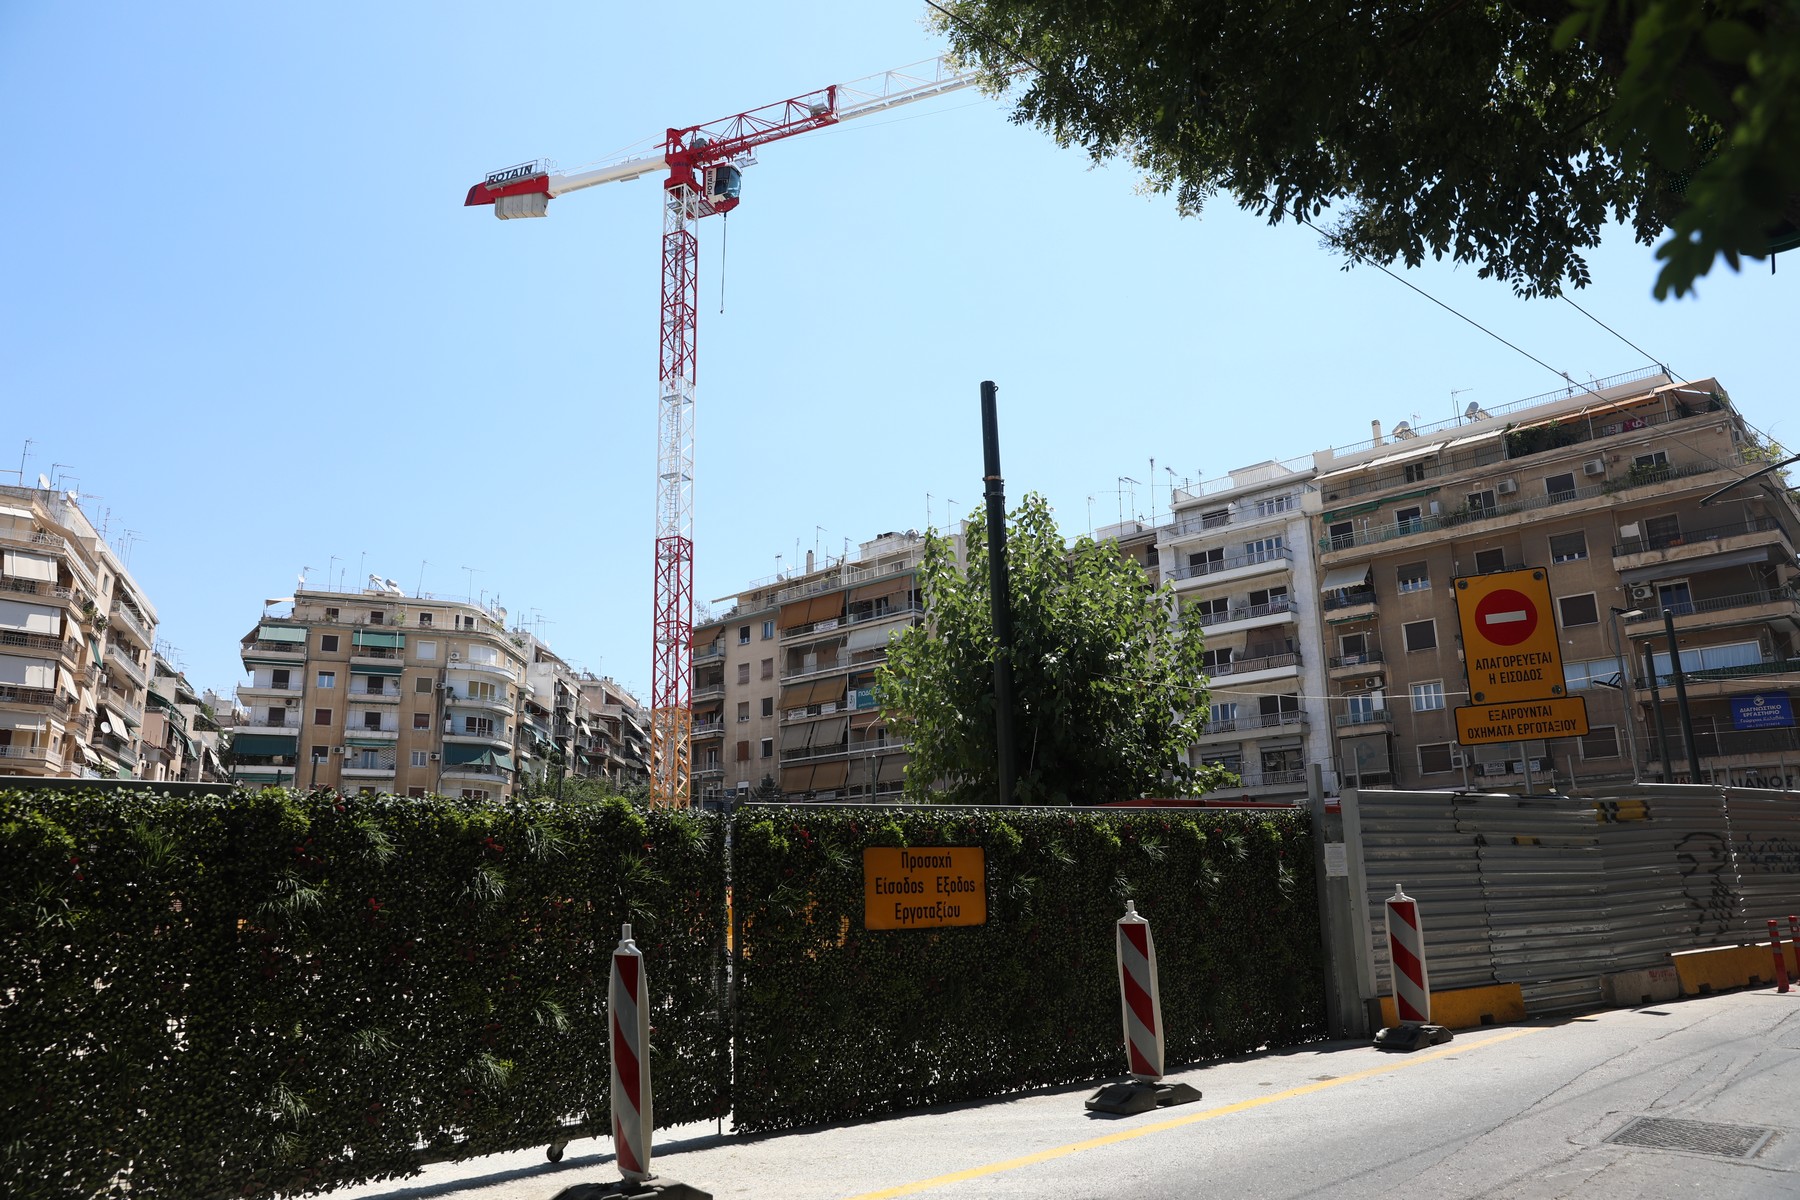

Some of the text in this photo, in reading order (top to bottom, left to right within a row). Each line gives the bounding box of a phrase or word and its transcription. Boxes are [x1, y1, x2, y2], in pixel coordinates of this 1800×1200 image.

[1475, 651, 1553, 671] ΑΠΑΓΟΡΕΥΕΤΑΙ
[1489, 668, 1543, 685] Η ΕΙΣΟΔΟΣ
[1488, 705, 1552, 722] ΕΞΑΙΡΟΥΝΤΑΙ
[1739, 704, 1782, 713] ΔΙΑΓΝΩΣΤΙΚΟ
[1743, 710, 1780, 718] ΕΡΓΑΣΤΗΡΙΟ
[1467, 719, 1577, 739] ΟΧΗΜΑΤΑ ΕΡΓΟΤΑΞΙΟΥ
[901, 851, 952, 873] Προσοχή
[875, 876, 975, 897] Είσοδος Εξοδος
[895, 901, 960, 924] Εργοταξίου
